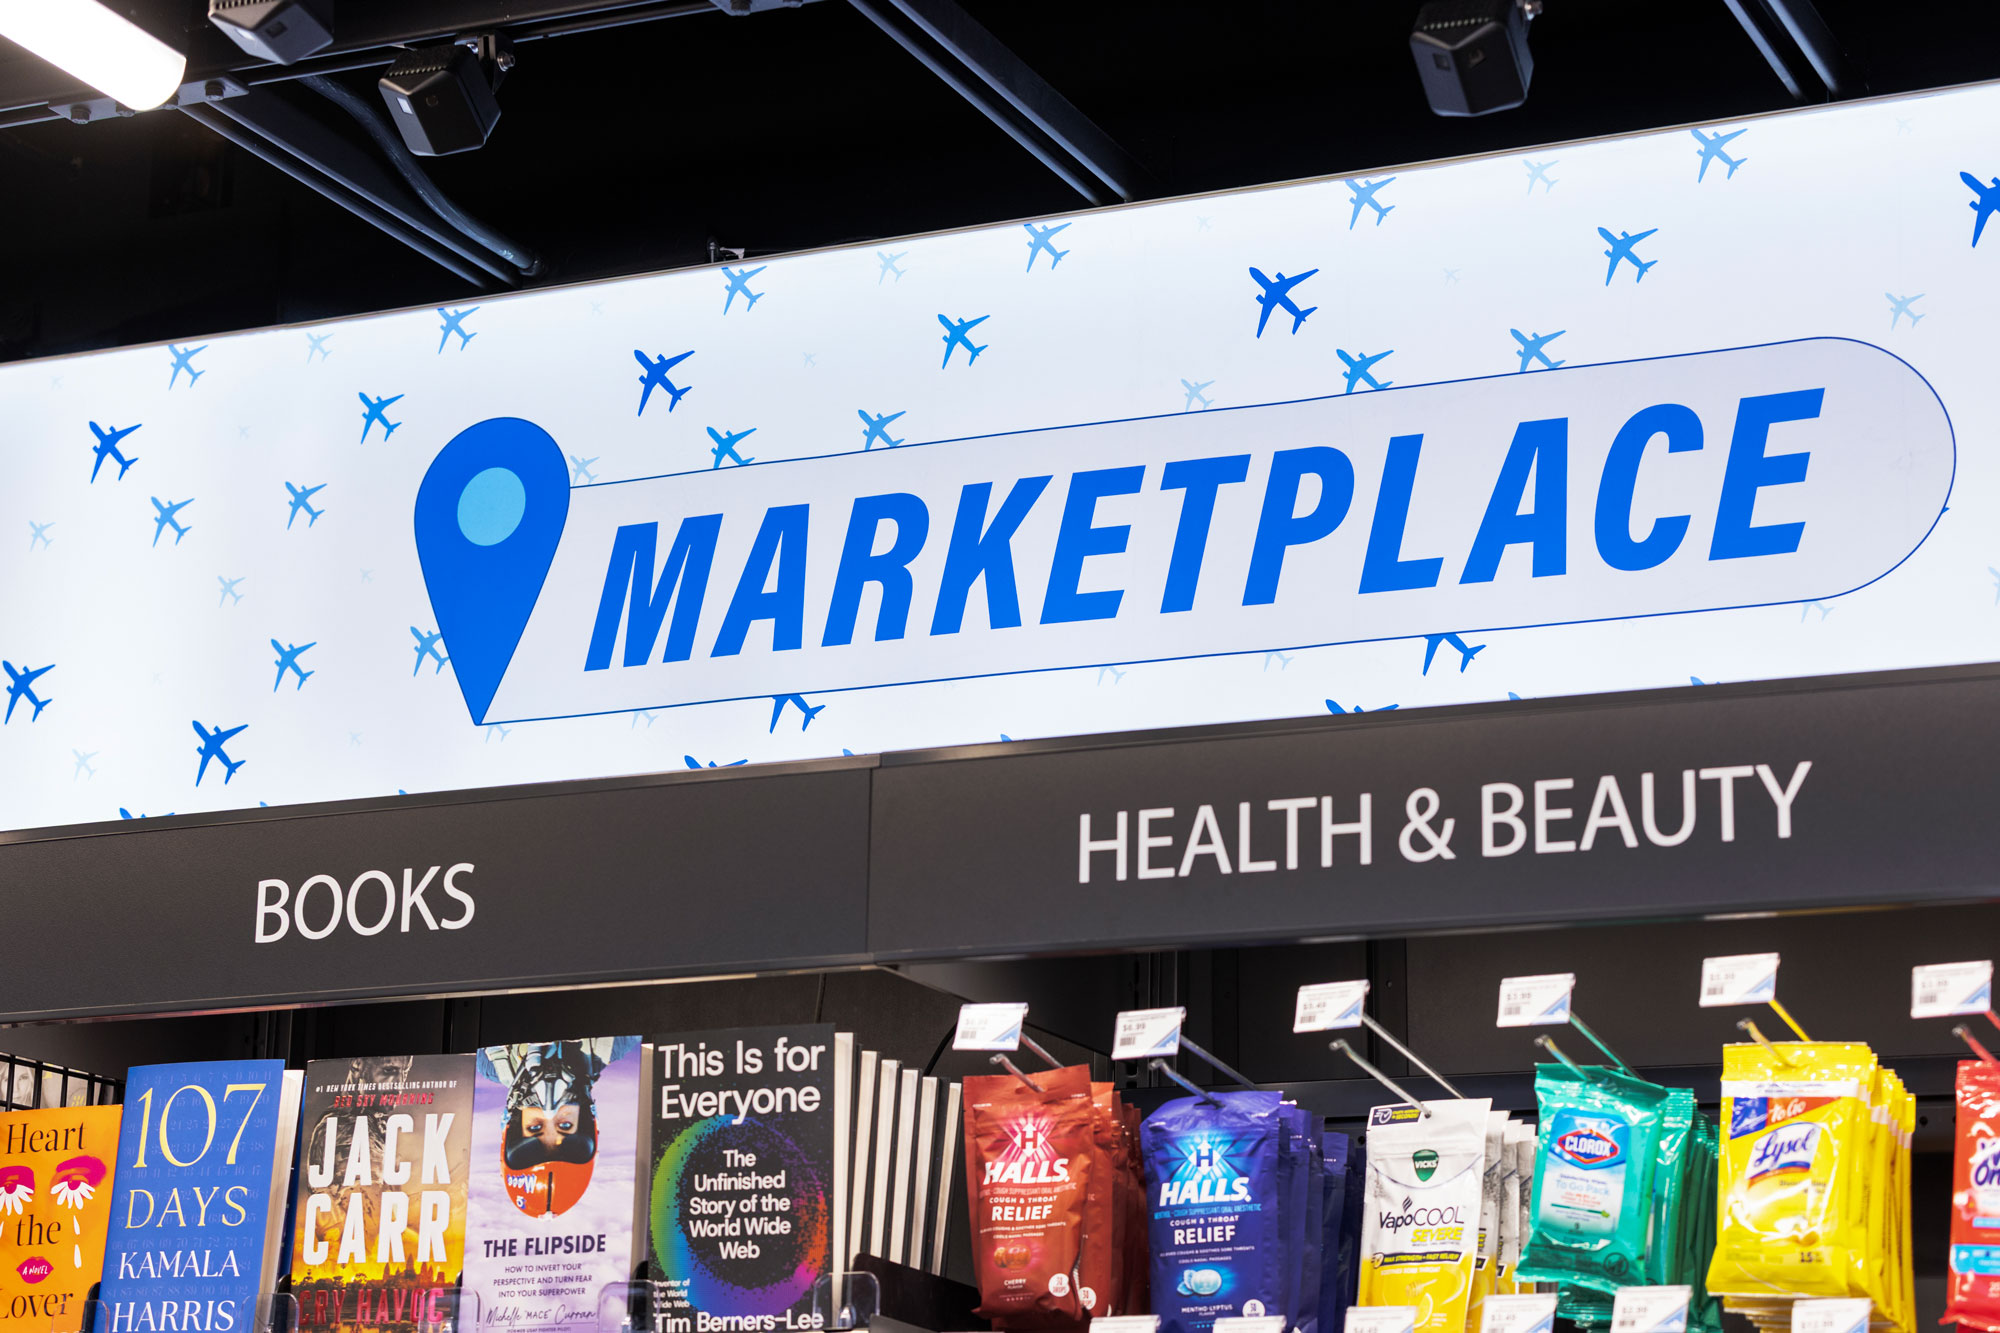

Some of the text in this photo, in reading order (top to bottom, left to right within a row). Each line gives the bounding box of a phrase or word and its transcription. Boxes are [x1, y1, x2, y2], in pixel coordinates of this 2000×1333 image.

[584, 387, 1825, 671] MARKETPLACE
[1079, 761, 1812, 883] HEALTH & BEAUTY
[255, 862, 475, 943] BOOKS
[658, 1036, 826, 1079] This Is for
[341, 1084, 355, 1092] YORK
[358, 1083, 376, 1092] TIMES
[378, 1081, 420, 1091] BESTSELLING
[422, 1081, 447, 1089] AUTHOR
[449, 1080, 457, 1088] OF
[356, 1094, 375, 1108] SKY
[661, 1085, 821, 1125] Everyone
[1787, 1098, 1806, 1117] Go
[133, 1083, 266, 1168] 107
[6, 1122, 87, 1155] Heart
[1565, 1136, 1612, 1157] CLOROX
[1754, 1128, 1816, 1168] Lysol
[308, 1113, 455, 1188] JACK
[723, 1149, 757, 1168] The
[1415, 1161, 1438, 1169] VICKS
[694, 1170, 786, 1192] Unfinished
[125, 1186, 248, 1228] DAYS
[689, 1193, 791, 1218] Story of the
[1028, 1195, 1058, 1203] THROAT
[991, 1204, 1053, 1222] RELIEF
[1170, 1219, 1197, 1227] COUGH
[1208, 1215, 1240, 1223] THROAT
[1379, 1206, 1464, 1234] VapoCOOL
[16, 1214, 61, 1246] the
[303, 1191, 450, 1265] CARR
[689, 1215, 792, 1238] World Wide
[1174, 1225, 1236, 1245] RELIEF
[1411, 1227, 1463, 1242] SEVERE
[484, 1234, 606, 1258] THE FLIPSIDE
[718, 1240, 760, 1260] Web
[22, 1264, 49, 1275] A NOVEL
[118, 1250, 240, 1279] KAMALA
[536, 1264, 560, 1272] INVERT
[493, 1278, 535, 1286] PERSPECTIVE
[537, 1276, 553, 1284] AND
[1004, 1278, 1026, 1286] CHERRY
[498, 1288, 585, 1298] INTO YOUR SUPERPOWER
[666, 1289, 688, 1298] World
[673, 1300, 690, 1308] Web
[112, 1300, 235, 1332] HARRIS
[299, 1288, 445, 1326] CRY HAVOC
[486, 1306, 521, 1327] Michelle
[555, 1304, 595, 1325] Curran
[653, 1309, 824, 1333] Tim Berners-Lee
